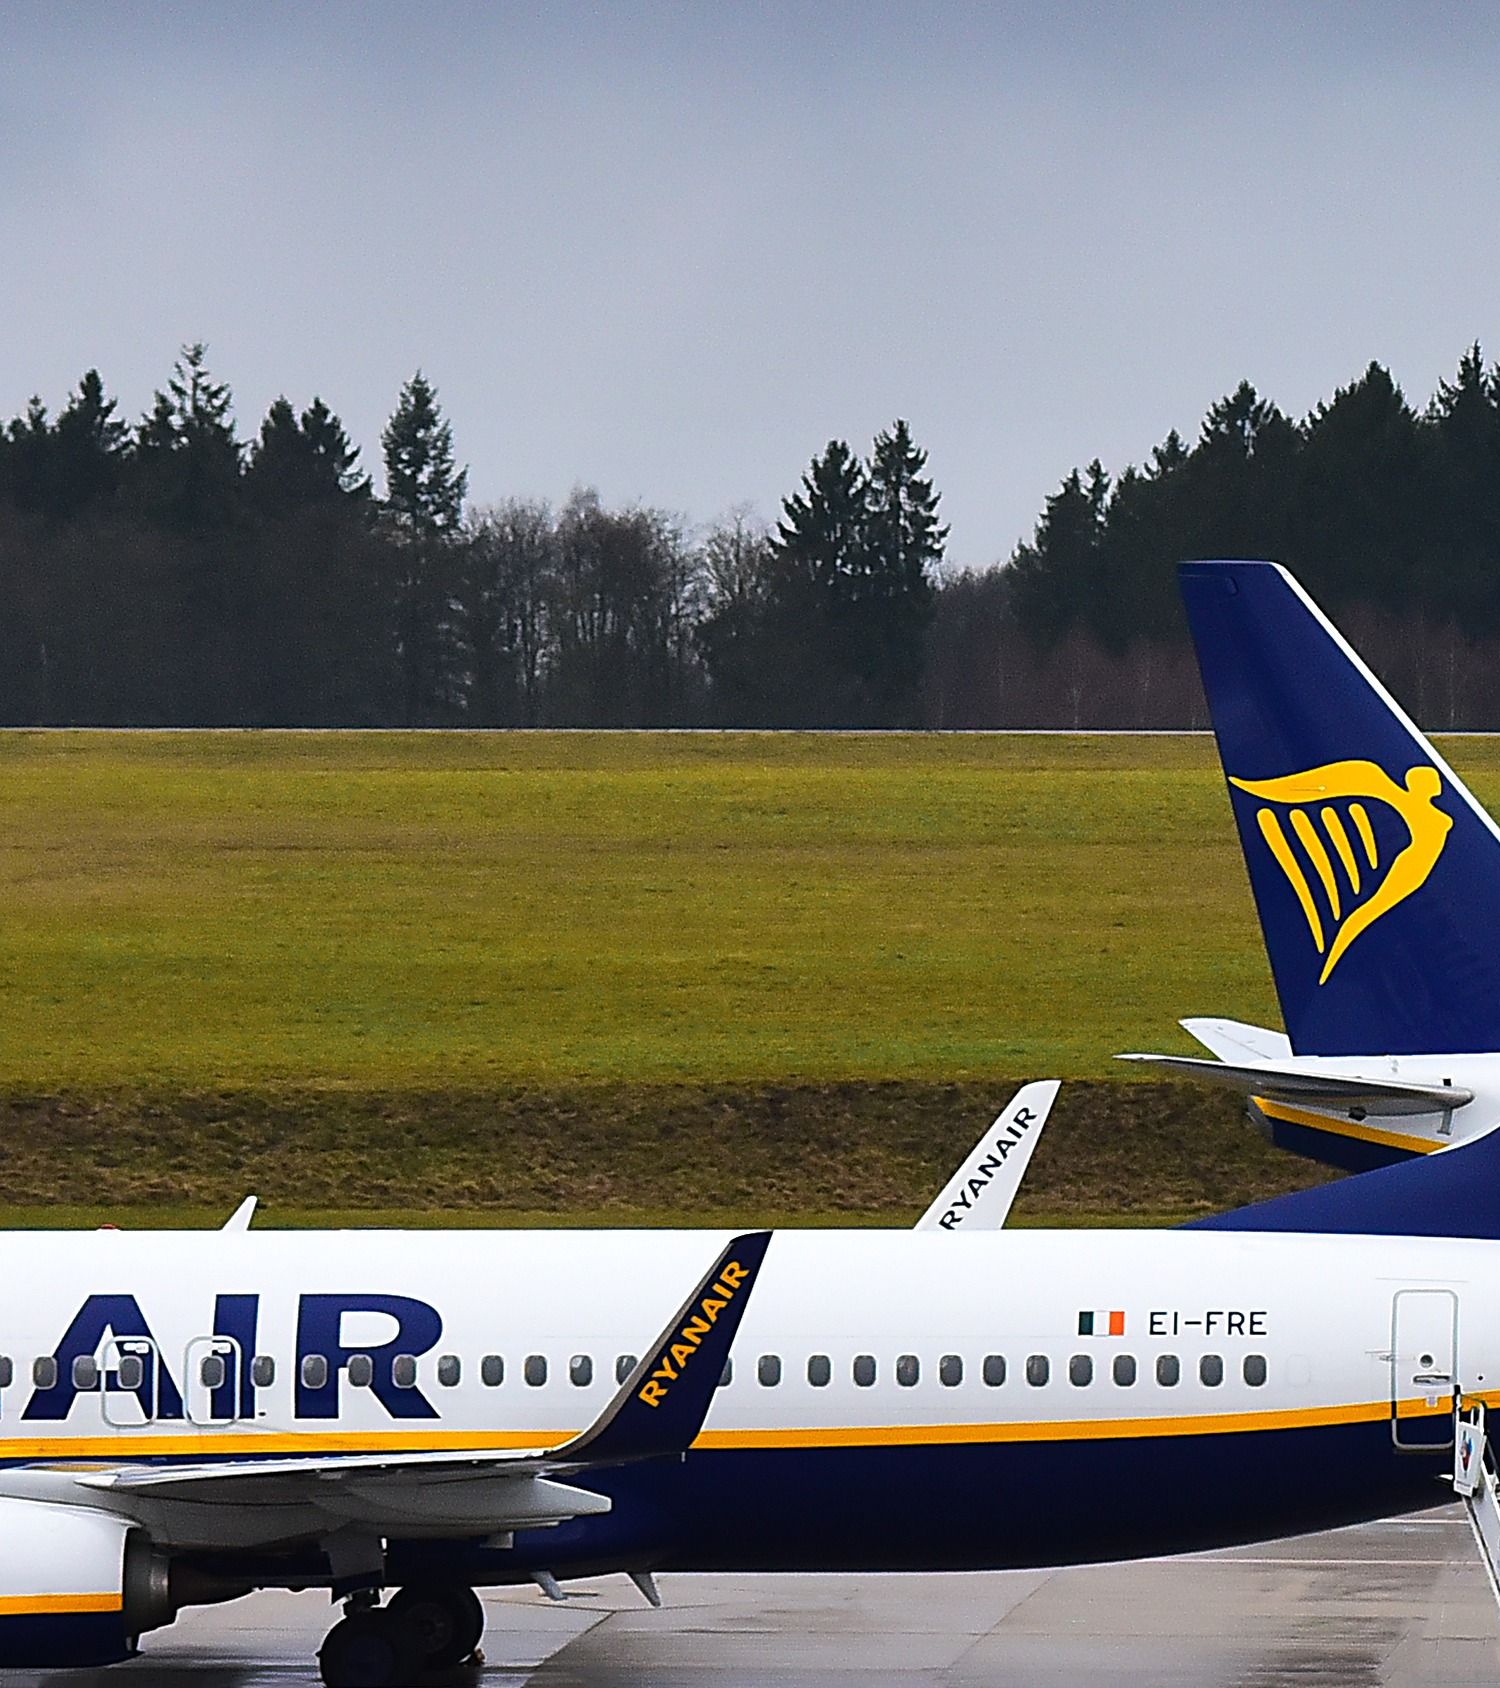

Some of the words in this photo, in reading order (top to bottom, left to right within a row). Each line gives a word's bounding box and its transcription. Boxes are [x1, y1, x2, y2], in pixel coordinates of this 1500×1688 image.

[939, 1107, 1037, 1230] RYANAIR
[20, 1294, 443, 1420] AIR
[638, 1261, 750, 1408] RYANAIR
[1149, 1302, 1267, 1336] EI-FRE
